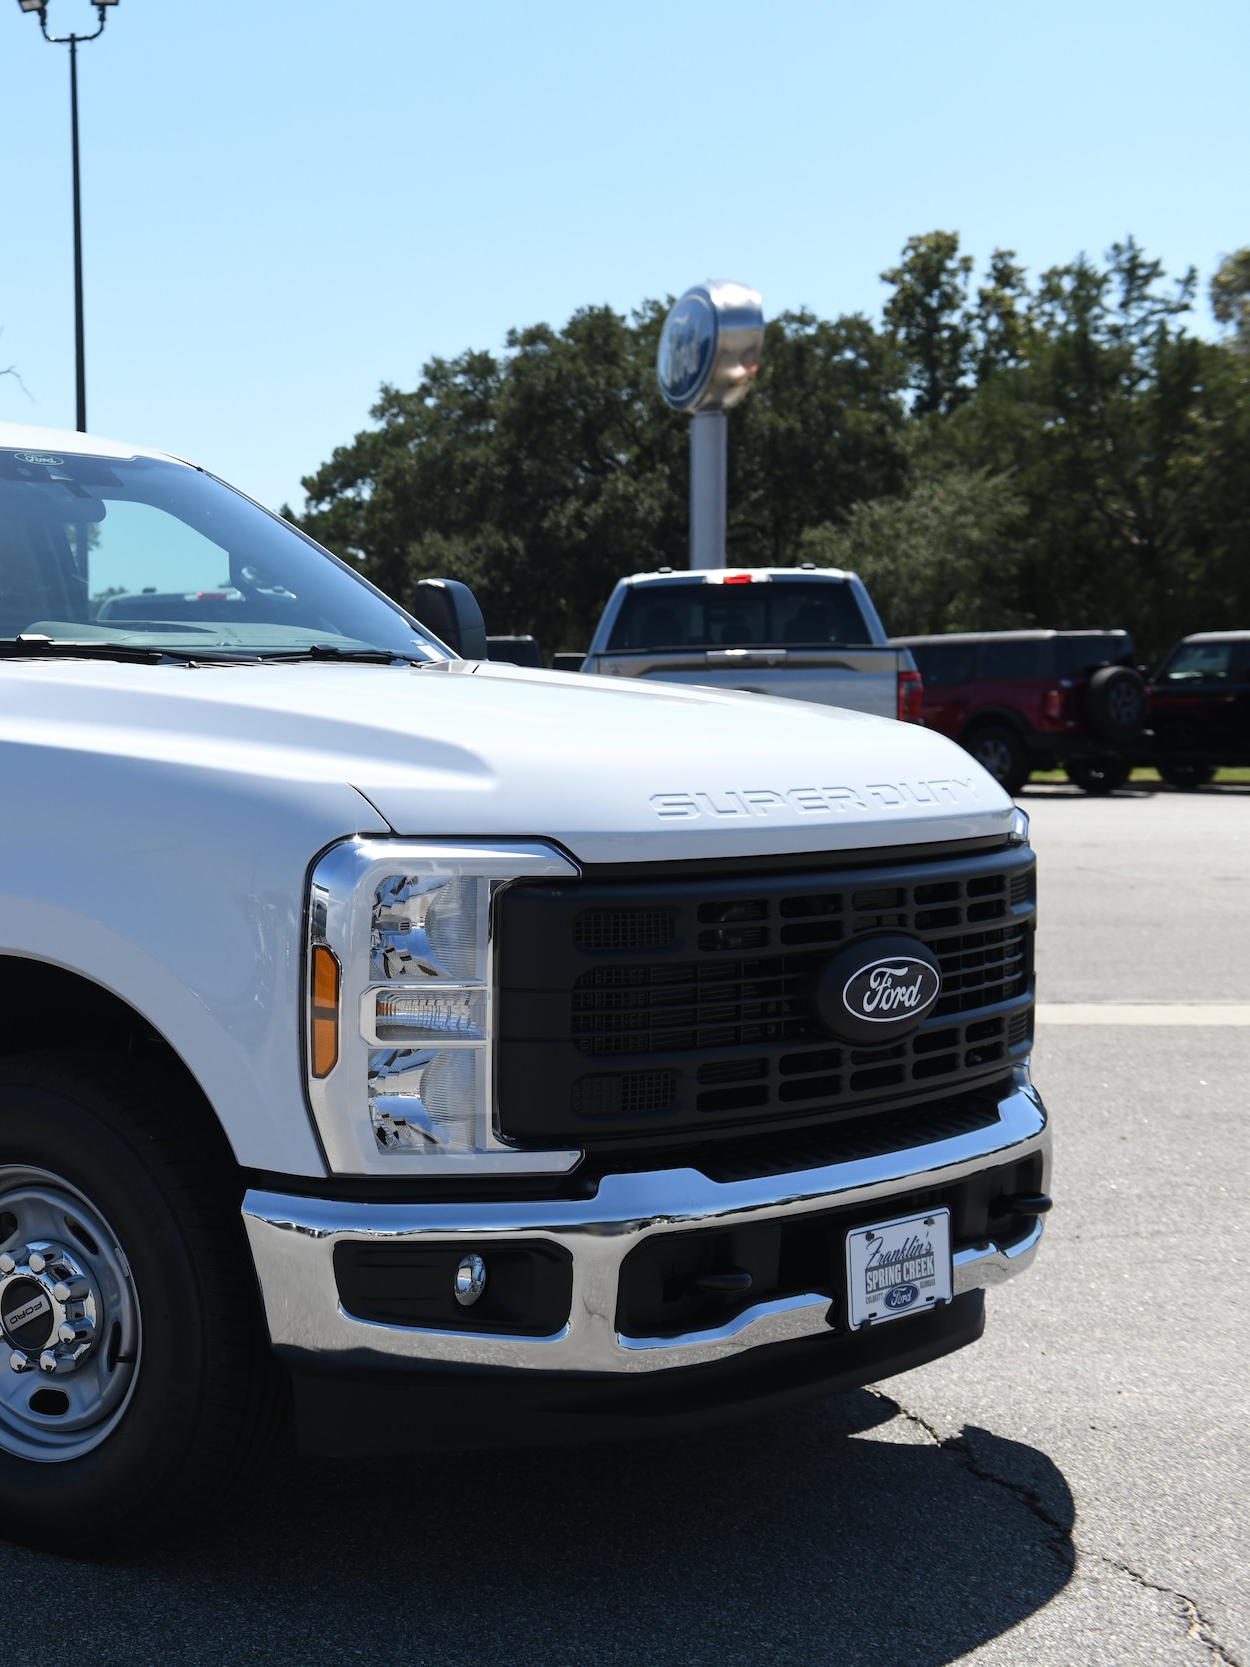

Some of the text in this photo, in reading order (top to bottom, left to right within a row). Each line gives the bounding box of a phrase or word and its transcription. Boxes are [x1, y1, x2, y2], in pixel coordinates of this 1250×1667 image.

[23, 452, 56, 464] Ford
[649, 778, 981, 820] SUPER DUTY
[863, 966, 923, 1013] Ford
[866, 1231, 933, 1268] Franklin's
[866, 1255, 934, 1292] SPRING CREEK
[10, 1302, 42, 1324] FORD
[891, 1287, 913, 1307] Ford
